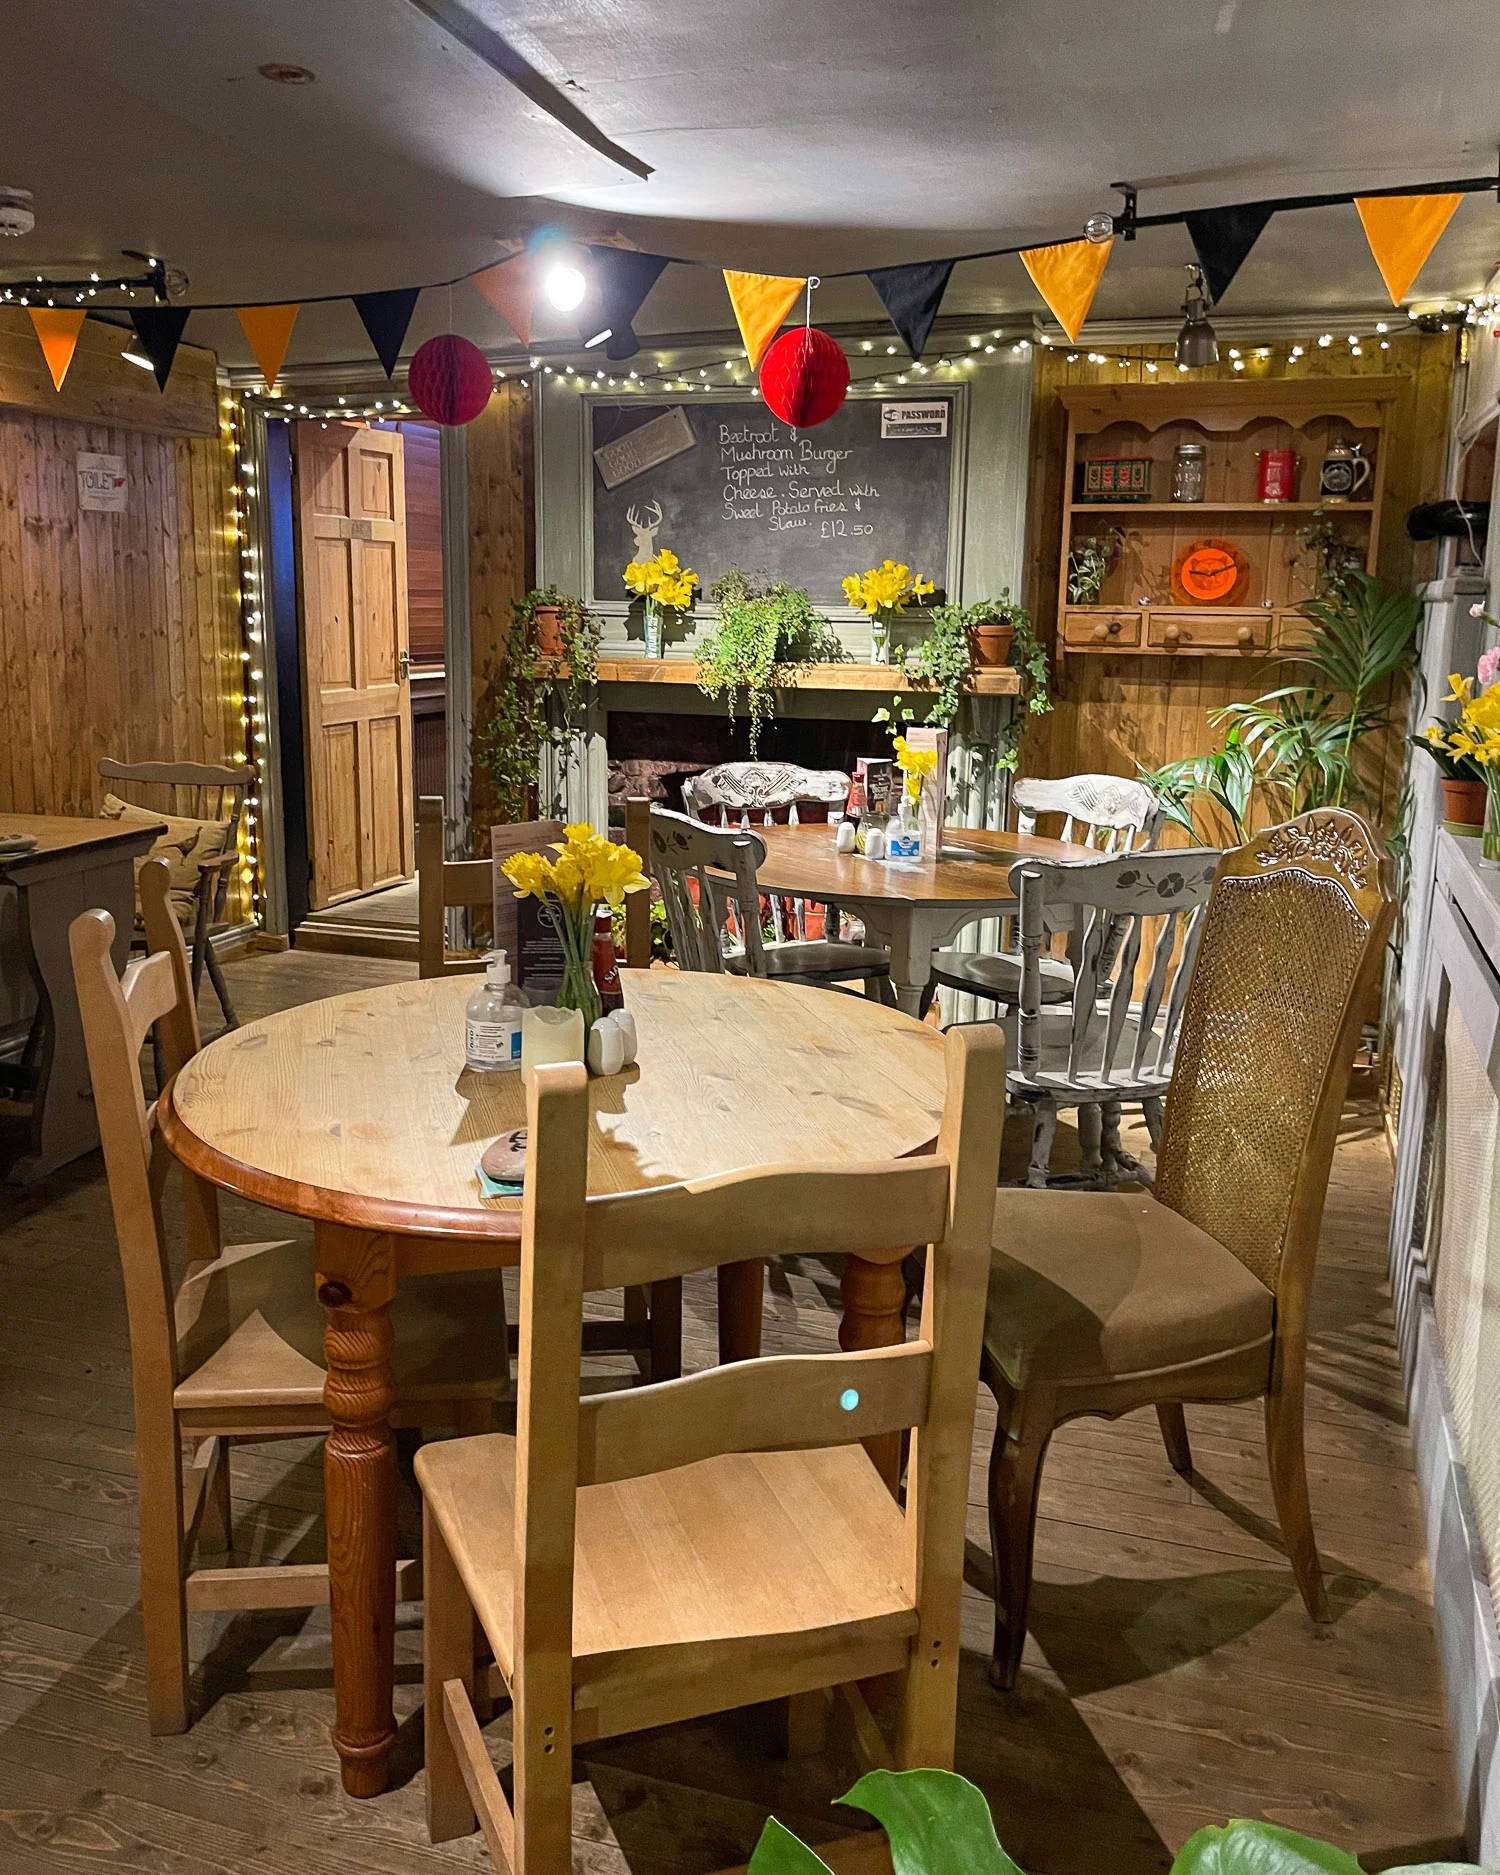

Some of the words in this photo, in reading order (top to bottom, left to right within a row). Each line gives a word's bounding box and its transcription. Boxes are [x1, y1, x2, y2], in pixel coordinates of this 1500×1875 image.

[901, 410, 946, 420] PASSWORD
[719, 422, 779, 444] Beetroot
[721, 443, 794, 462] Mushroom
[799, 439, 854, 474] Burger
[79, 470, 117, 490] TOILET
[720, 461, 774, 486] Topped
[788, 479, 844, 499] Served
[721, 502, 765, 520] Sweet
[772, 499, 811, 516] Potato
[820, 519, 874, 539] £12.50
